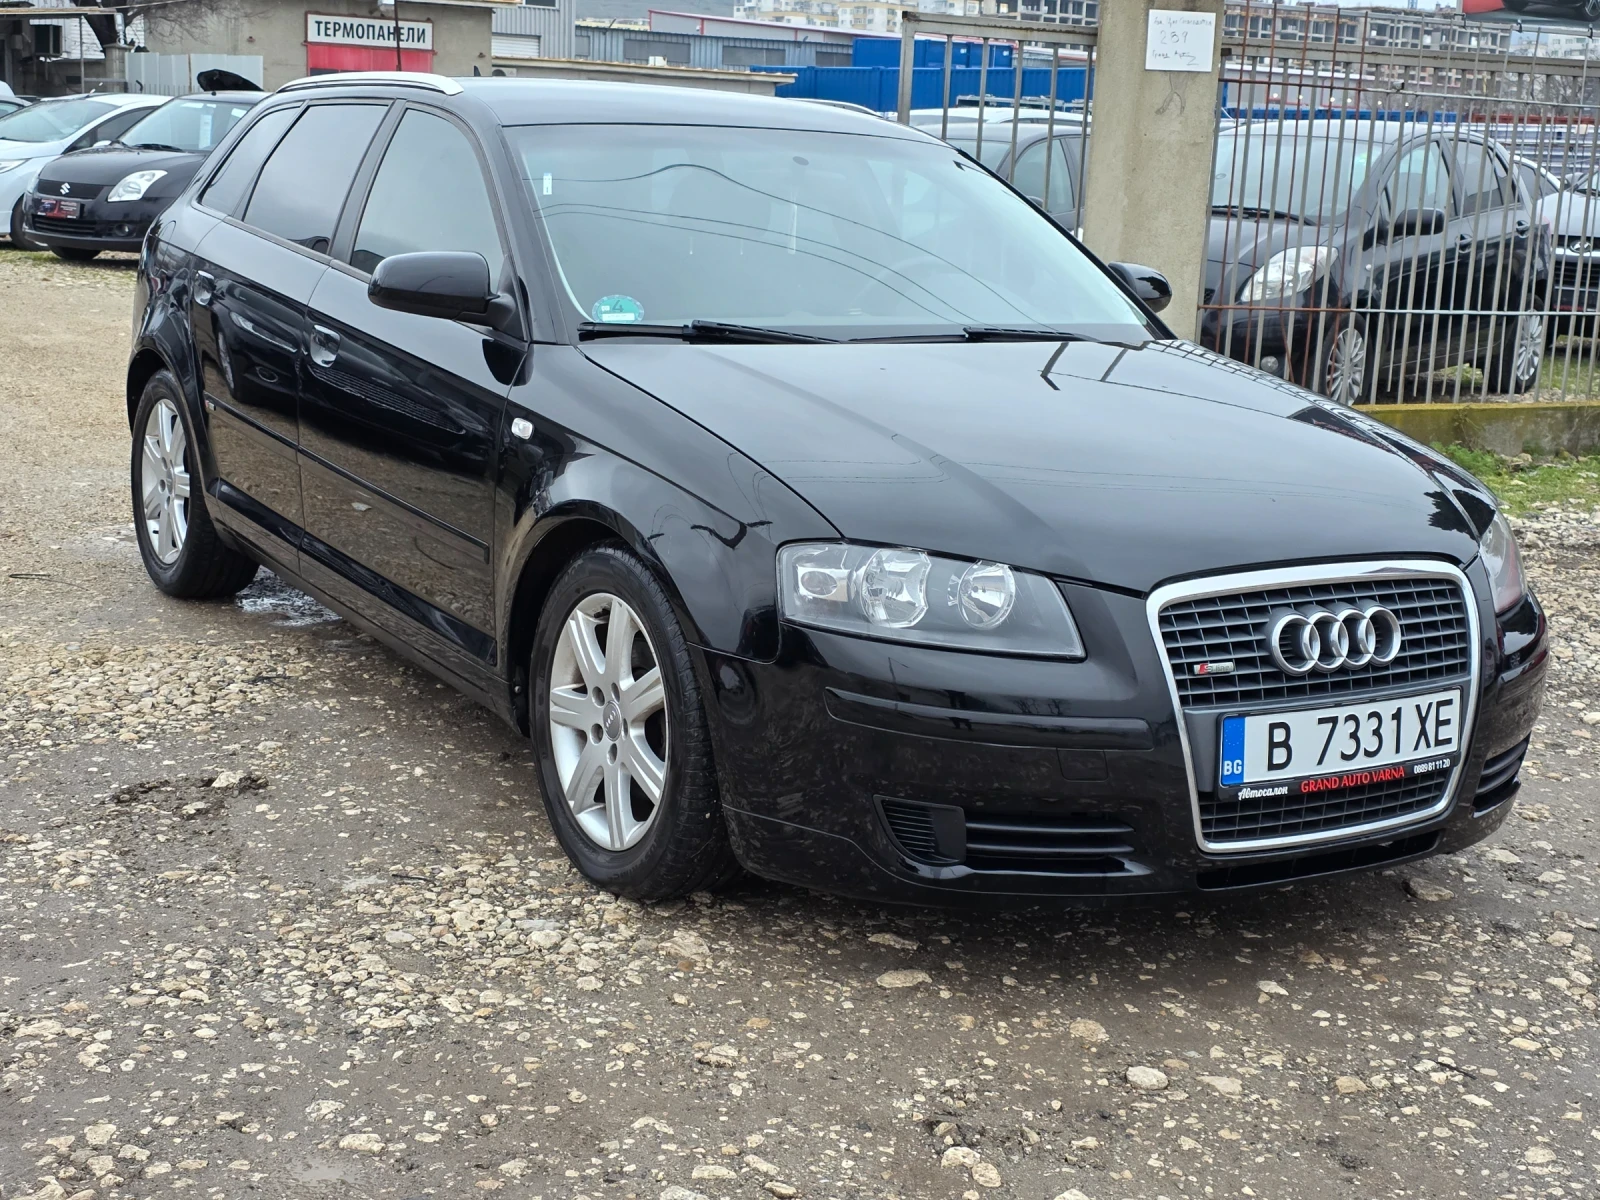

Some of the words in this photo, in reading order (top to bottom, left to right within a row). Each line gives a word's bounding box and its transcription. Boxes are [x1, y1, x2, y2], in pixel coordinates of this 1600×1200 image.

[314, 20, 426, 44] ТЕРМОПАНЕЛИ
[611, 299, 625, 313] 4
[1266, 721, 1293, 772] B
[1316, 706, 1403, 766] 7331
[1413, 698, 1454, 752] XE
[1223, 759, 1243, 776] BG
[1301, 777, 1340, 793] GRAND
[1341, 771, 1371, 787] AUTO
[1371, 766, 1405, 782] VARNA
[1238, 786, 1289, 801] Автосалон
